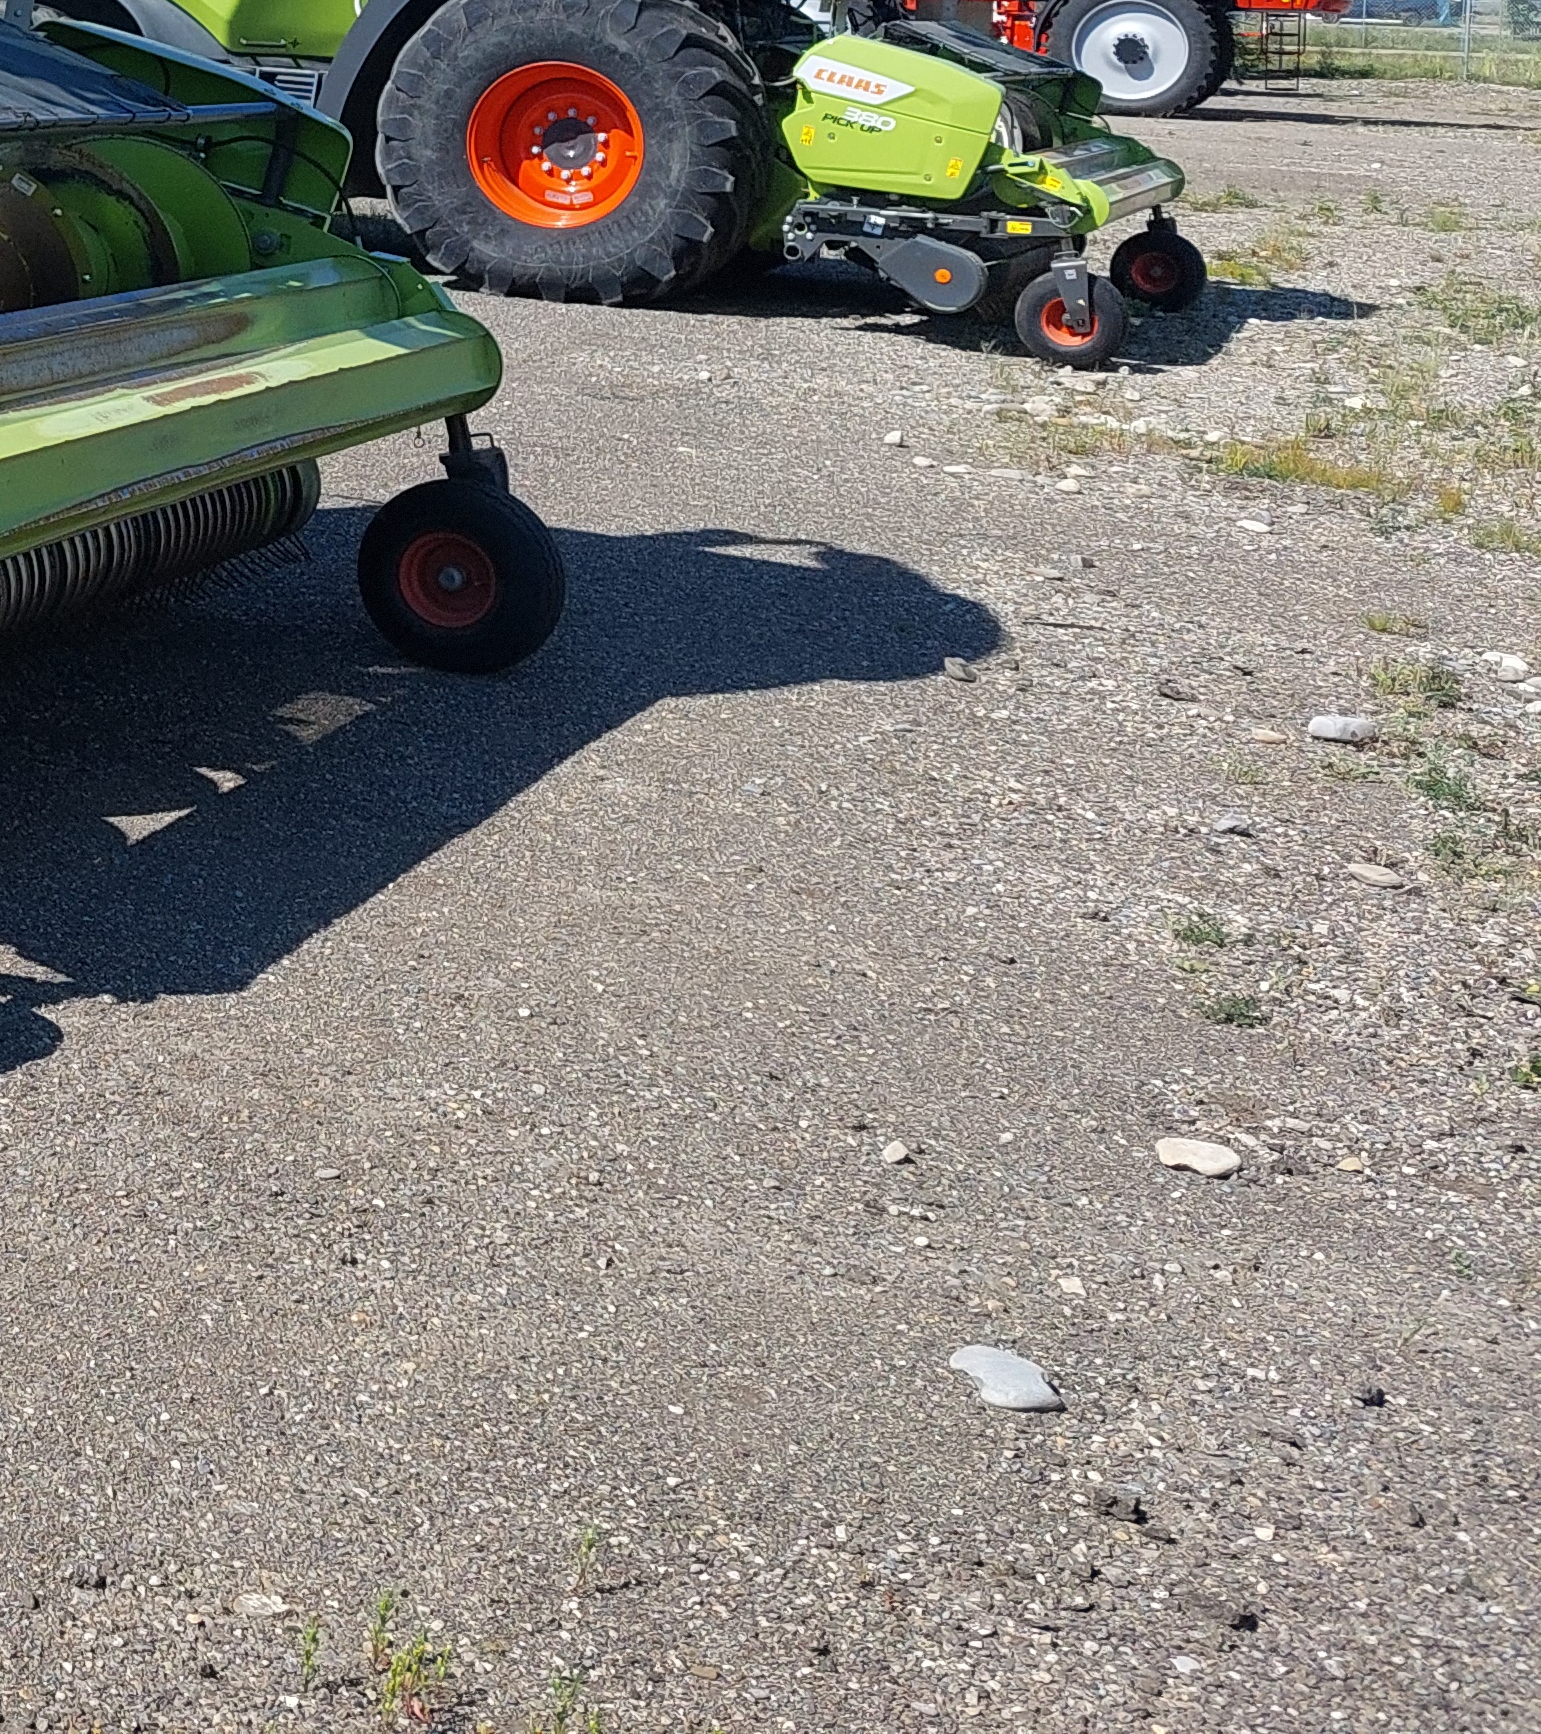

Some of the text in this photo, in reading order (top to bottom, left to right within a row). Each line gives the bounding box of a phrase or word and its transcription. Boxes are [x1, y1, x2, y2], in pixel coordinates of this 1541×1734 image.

[814, 68, 887, 96] CLAAS
[821, 113, 882, 134] PICK UP
[843, 106, 896, 131] 380
